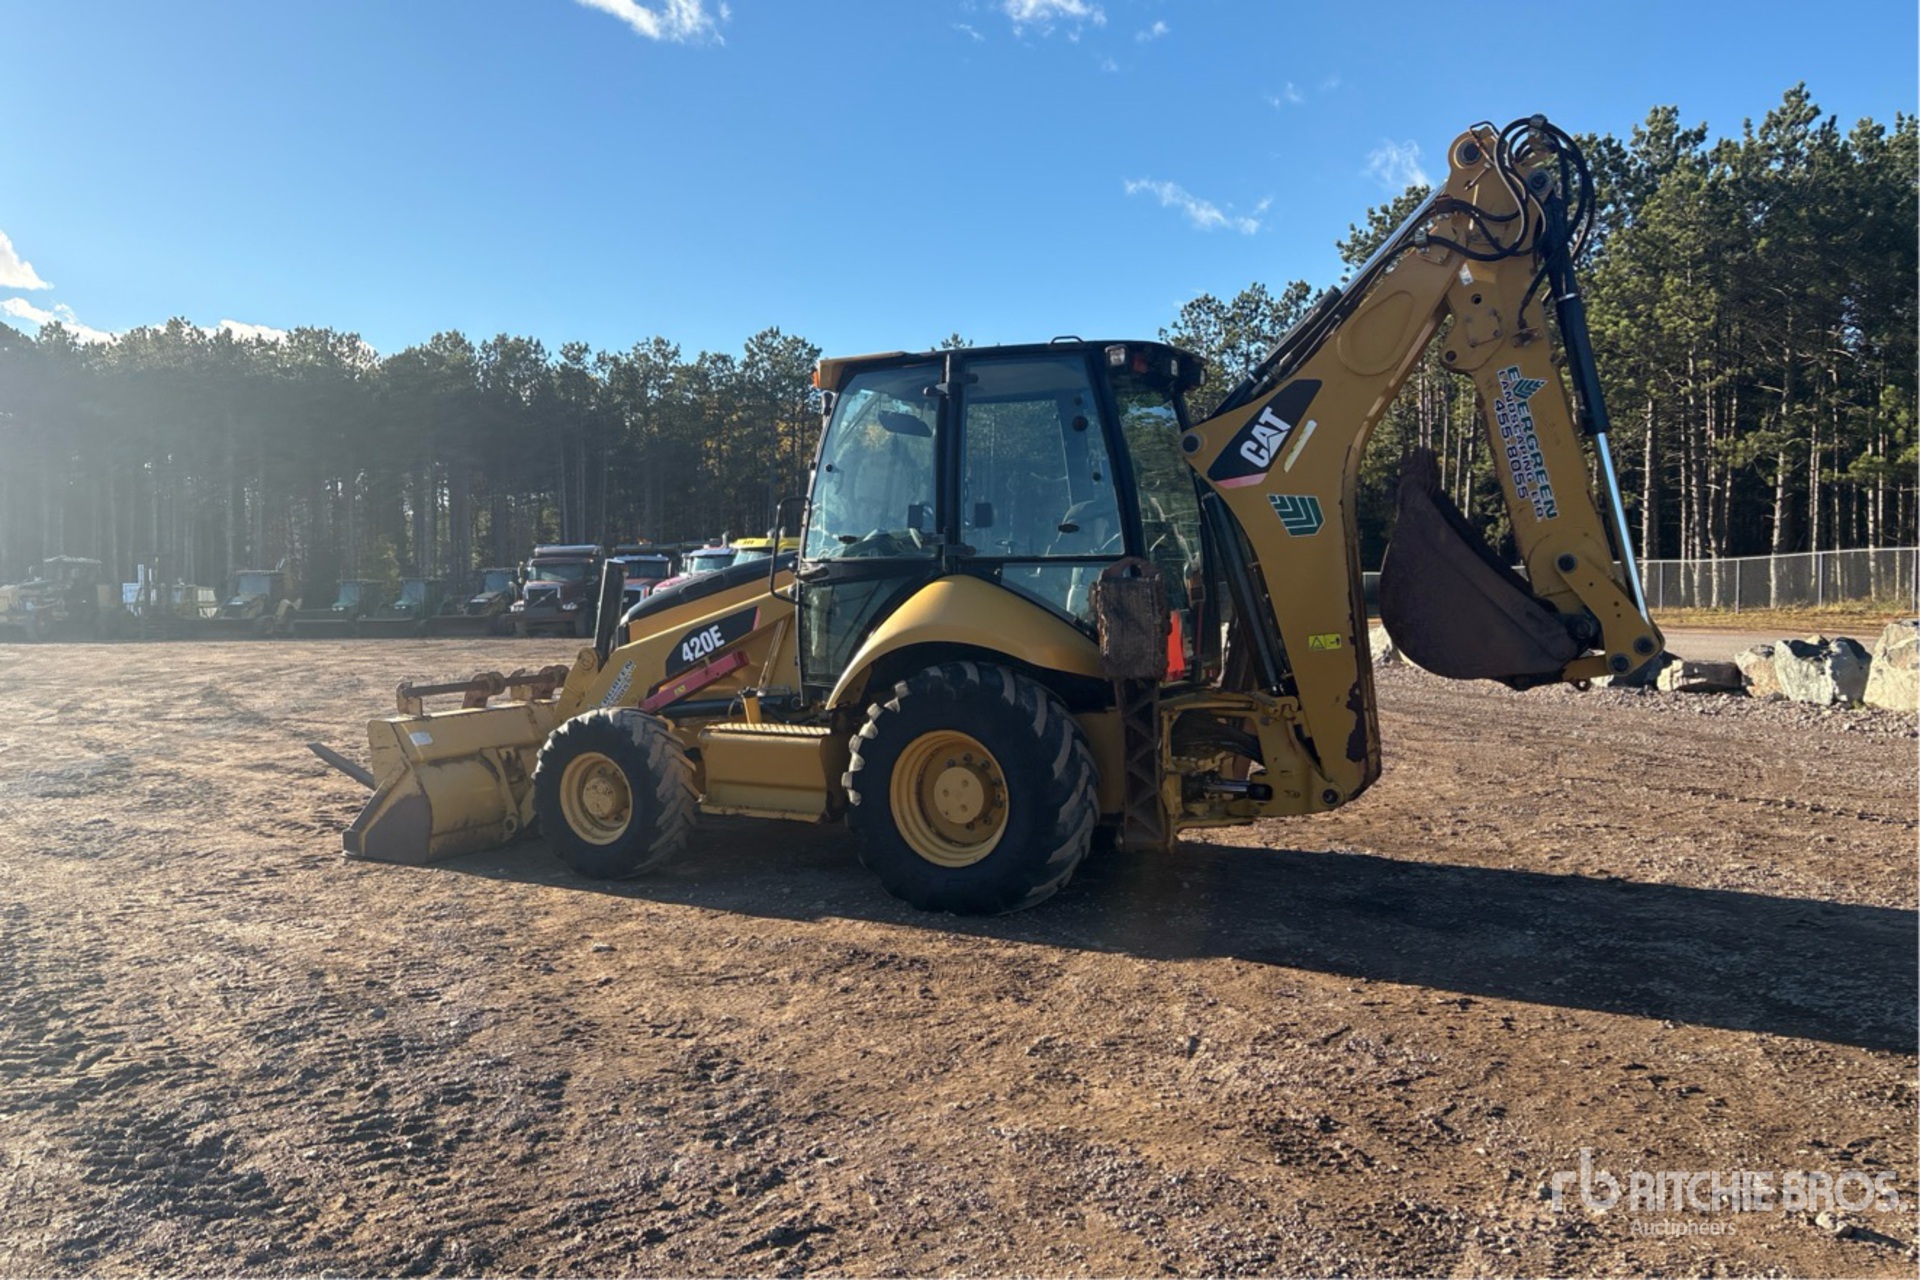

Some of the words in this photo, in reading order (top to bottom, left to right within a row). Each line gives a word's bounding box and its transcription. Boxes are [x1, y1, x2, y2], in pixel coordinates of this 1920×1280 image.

[1240, 406, 1291, 468] CAT
[1499, 371, 1534, 483] LANDSCAPING
[681, 624, 725, 663] 420E
